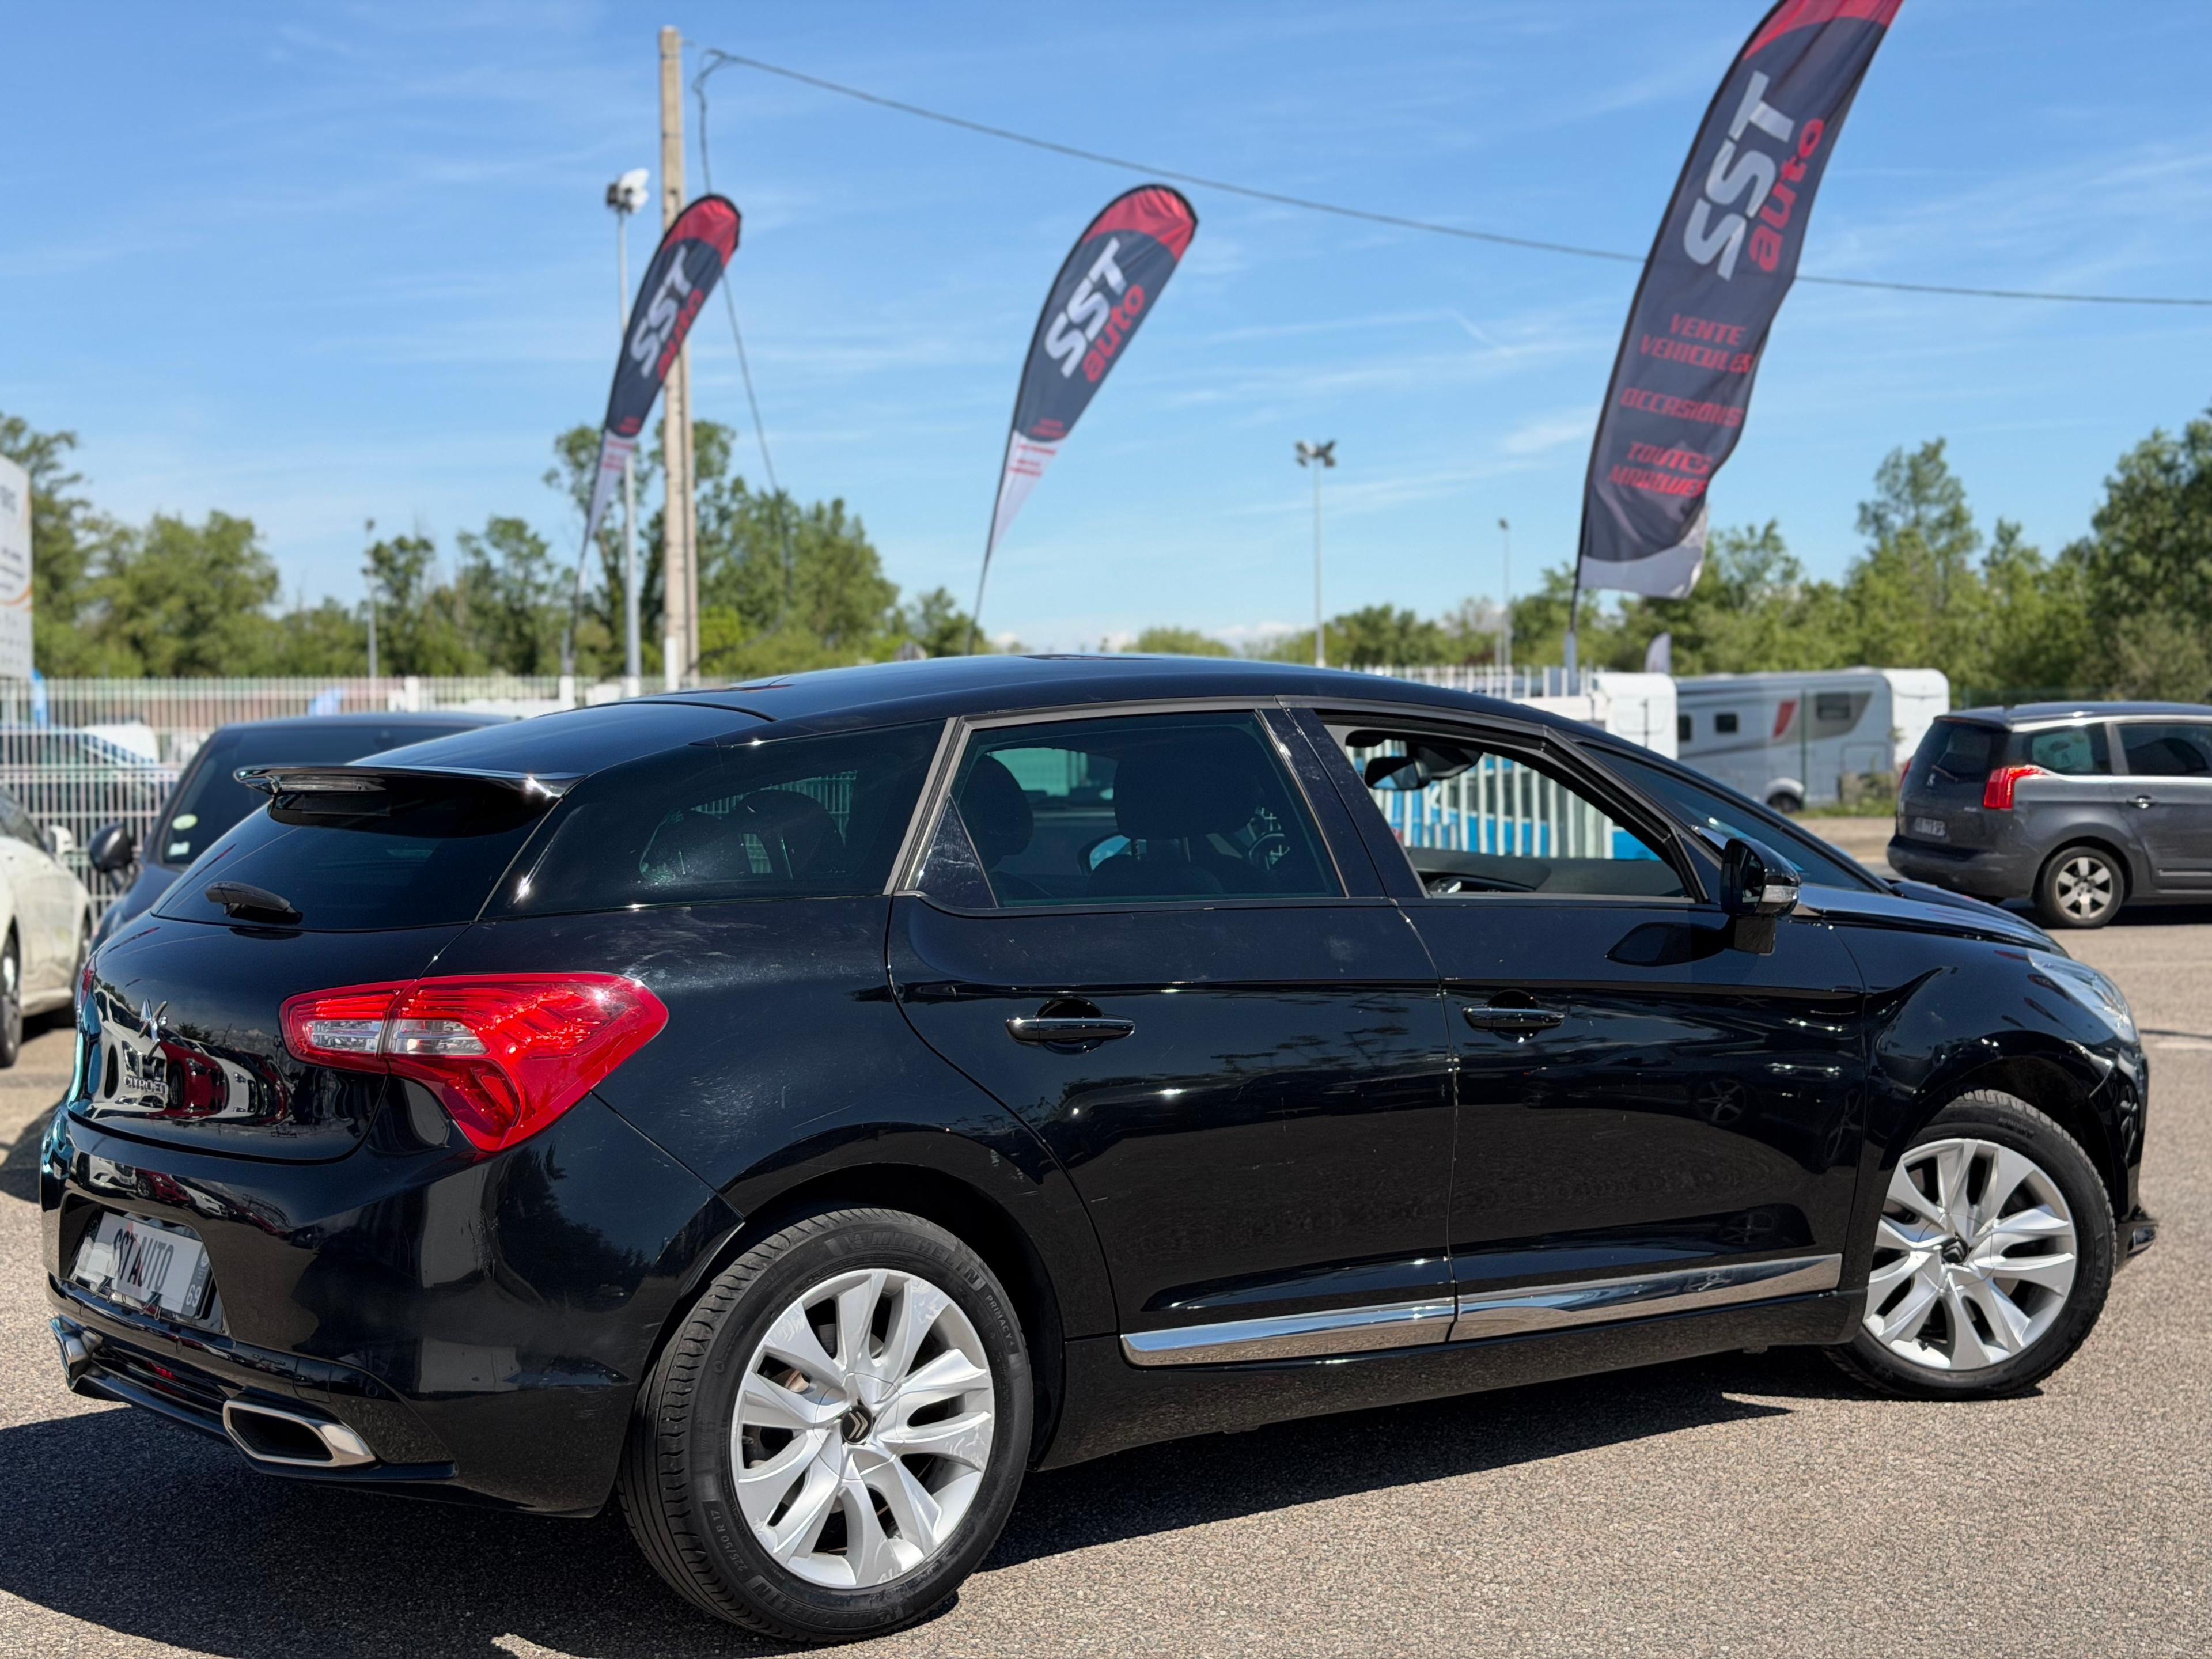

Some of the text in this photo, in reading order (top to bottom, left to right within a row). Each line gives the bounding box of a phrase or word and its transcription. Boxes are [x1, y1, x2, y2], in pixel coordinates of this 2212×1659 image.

[1683, 70, 1795, 282] SST
[1749, 118, 1824, 272] auto
[630, 244, 691, 378] SST
[1045, 237, 1127, 378] SST
[1669, 313, 1747, 346] VENTE
[1081, 283, 1145, 382] auto
[1620, 387, 1744, 428] OCCASIONS
[1627, 441, 1713, 475] TOUTES
[126, 1236, 175, 1291] AUTO
[872, 1231, 980, 1285] MICHELIN
[185, 1284, 202, 1308] 69
[986, 1294, 1013, 1339] PRIMACY
[710, 1509, 720, 1522] 17
[715, 1524, 726, 1533] R
[718, 1535, 748, 1572] 225/50
